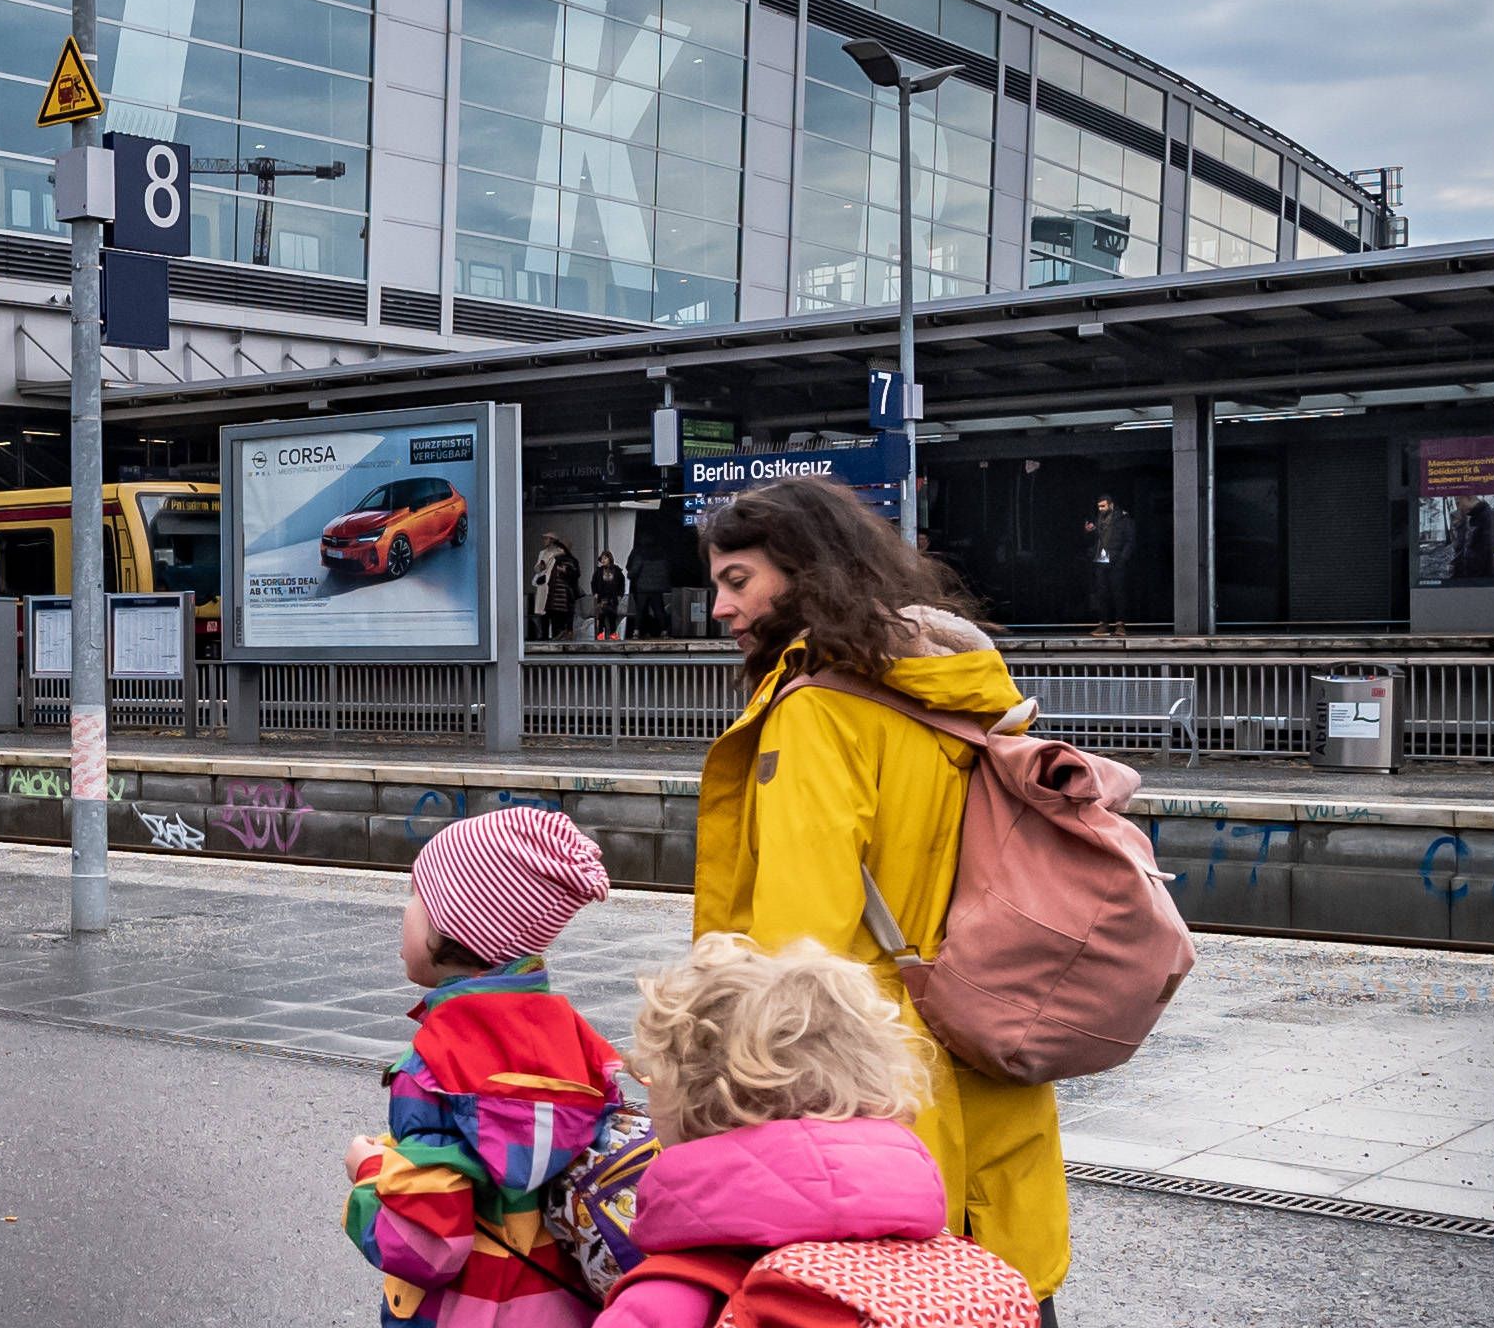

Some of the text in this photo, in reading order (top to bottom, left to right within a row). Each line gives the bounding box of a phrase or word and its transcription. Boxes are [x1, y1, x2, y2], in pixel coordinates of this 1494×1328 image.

[143, 144, 181, 228] 8
[877, 372, 892, 415] 7
[278, 445, 336, 466] CORSA
[693, 459, 832, 482] Berlin Ostkreuz
[249, 577, 319, 587] IM SORGLOS DEAL
[249, 587, 262, 595] AB
